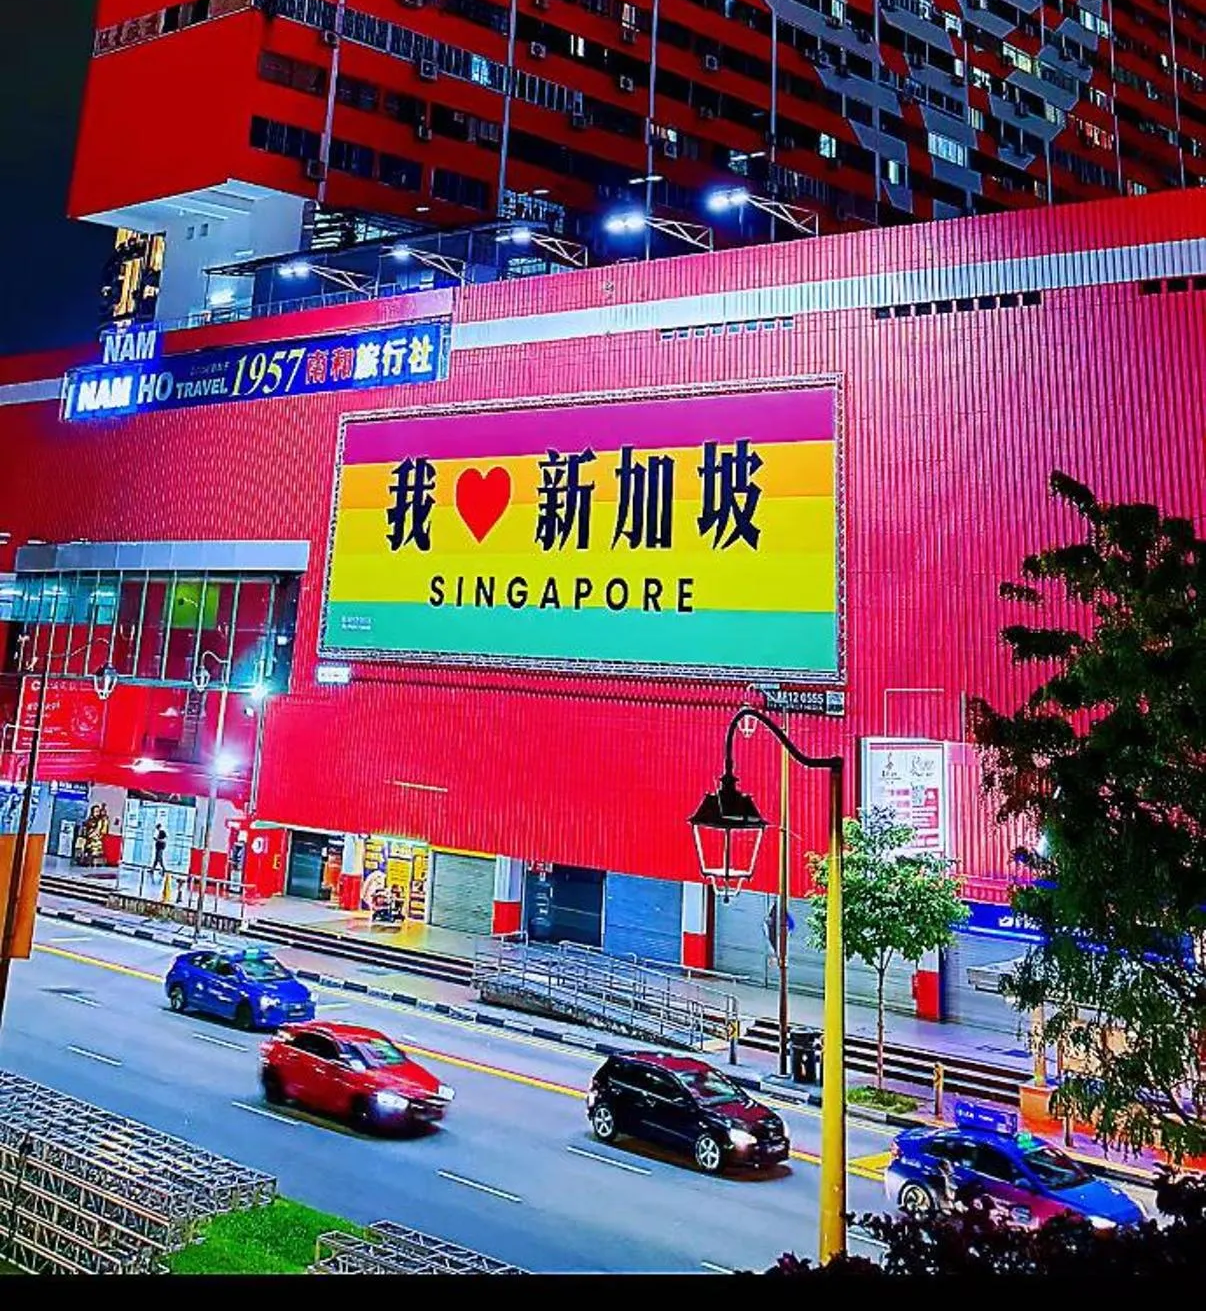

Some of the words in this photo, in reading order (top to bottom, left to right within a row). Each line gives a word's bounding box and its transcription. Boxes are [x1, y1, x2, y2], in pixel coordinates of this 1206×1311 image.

[102, 330, 157, 364] NAM
[76, 375, 134, 412] NAM
[137, 371, 174, 405] HO
[176, 377, 228, 400] TRAVEL
[229, 347, 306, 397] 1957
[385, 455, 437, 552] 我
[534, 439, 764, 551] 新加坡
[428, 574, 695, 613] SINGAPORE
